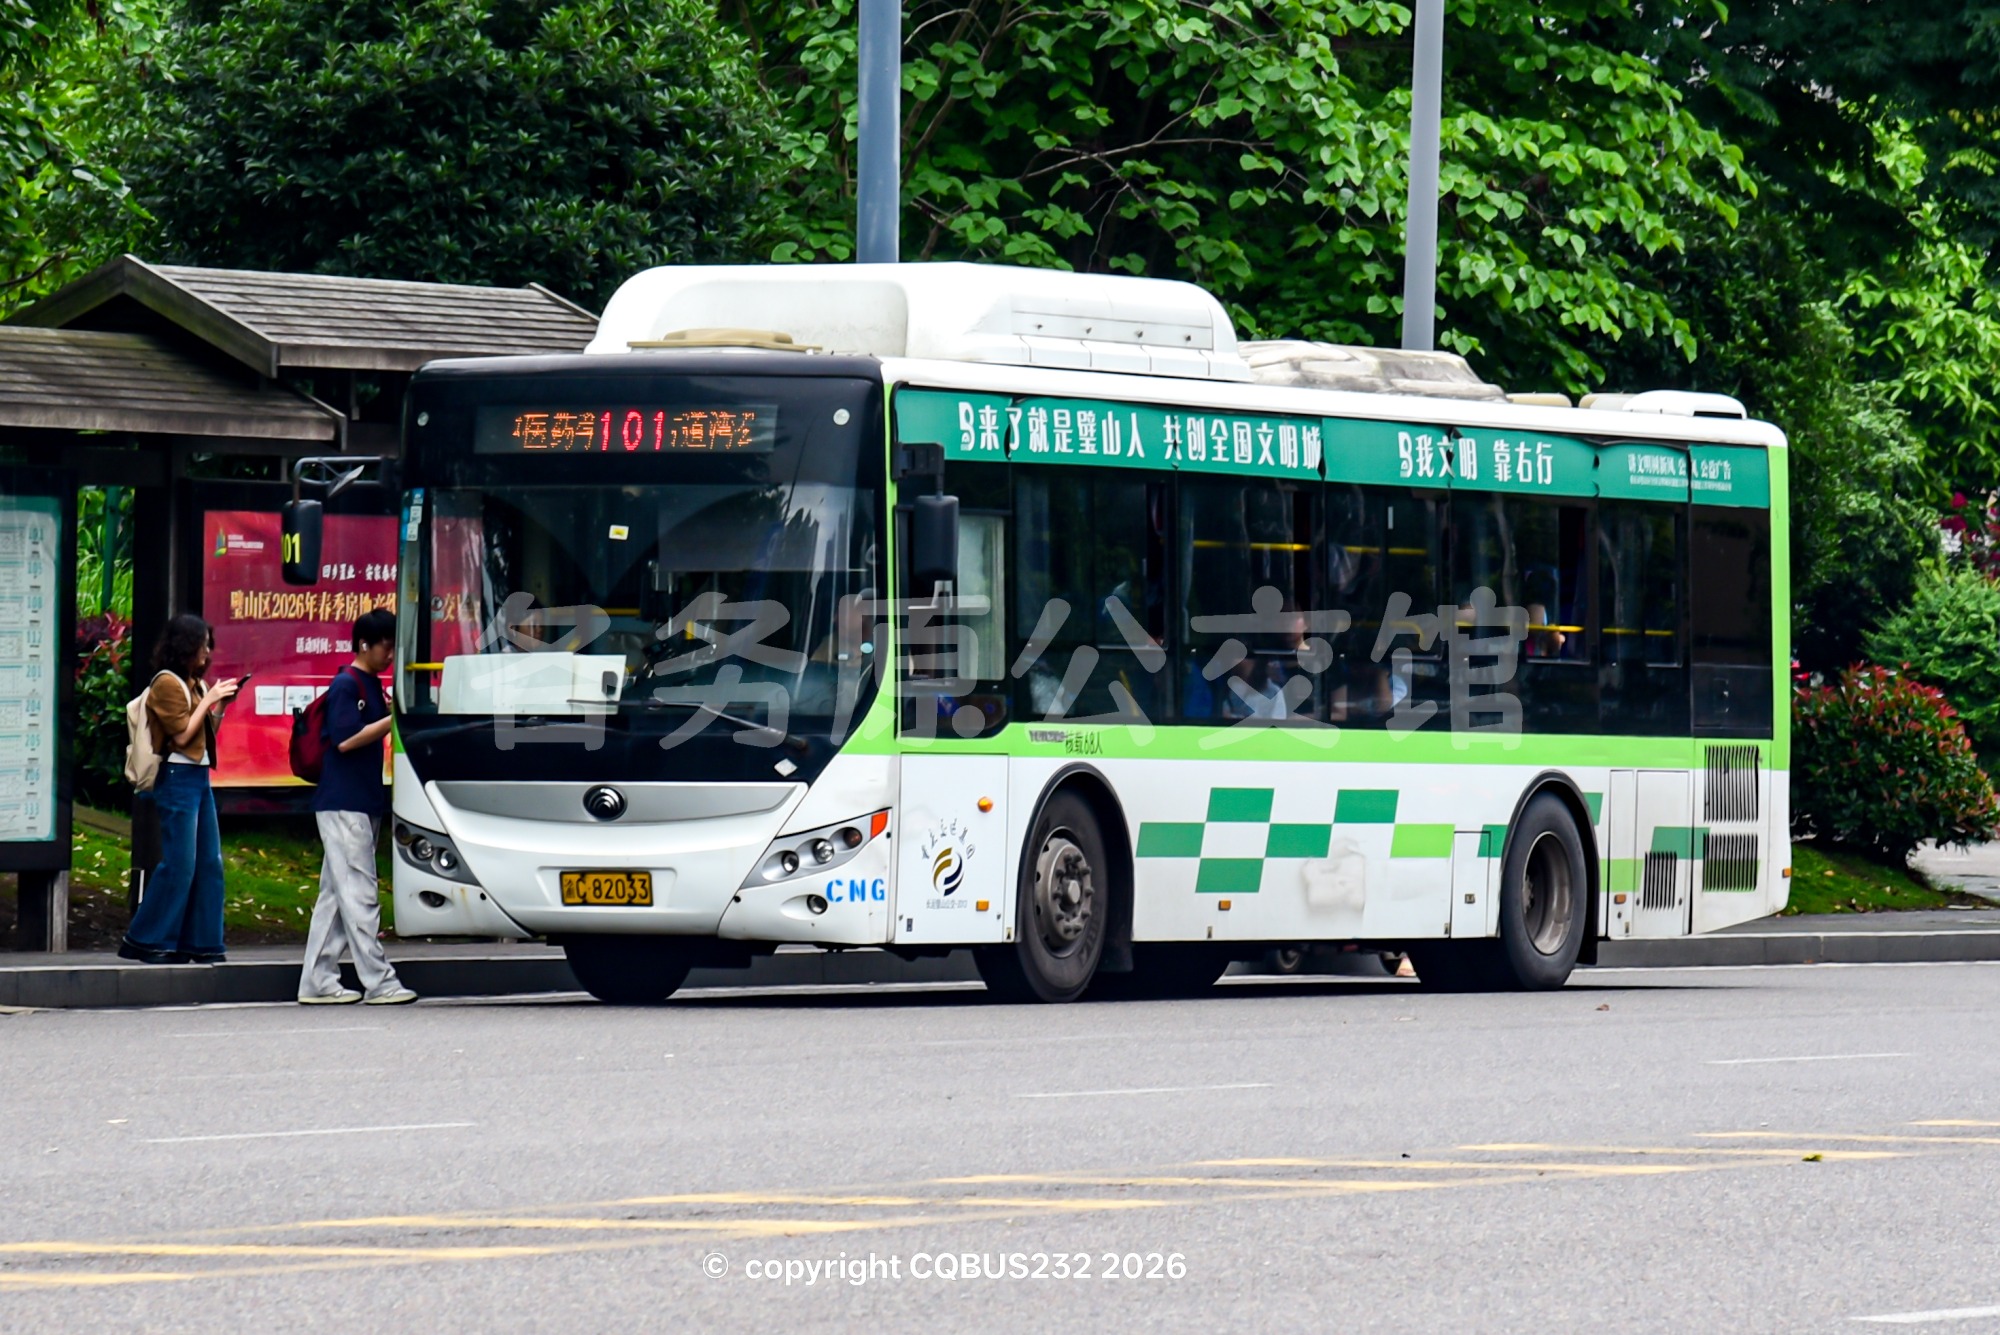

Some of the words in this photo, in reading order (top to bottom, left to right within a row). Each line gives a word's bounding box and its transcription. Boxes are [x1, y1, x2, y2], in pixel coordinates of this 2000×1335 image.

[600, 410, 665, 451] 101
[978, 404, 1146, 459] 来了就是璧山人
[1162, 414, 1322, 470] 共创全国文明城
[1415, 434, 1478, 481] 我文明
[1493, 440, 1554, 485] 靠右行
[826, 879, 885, 903] CNG
